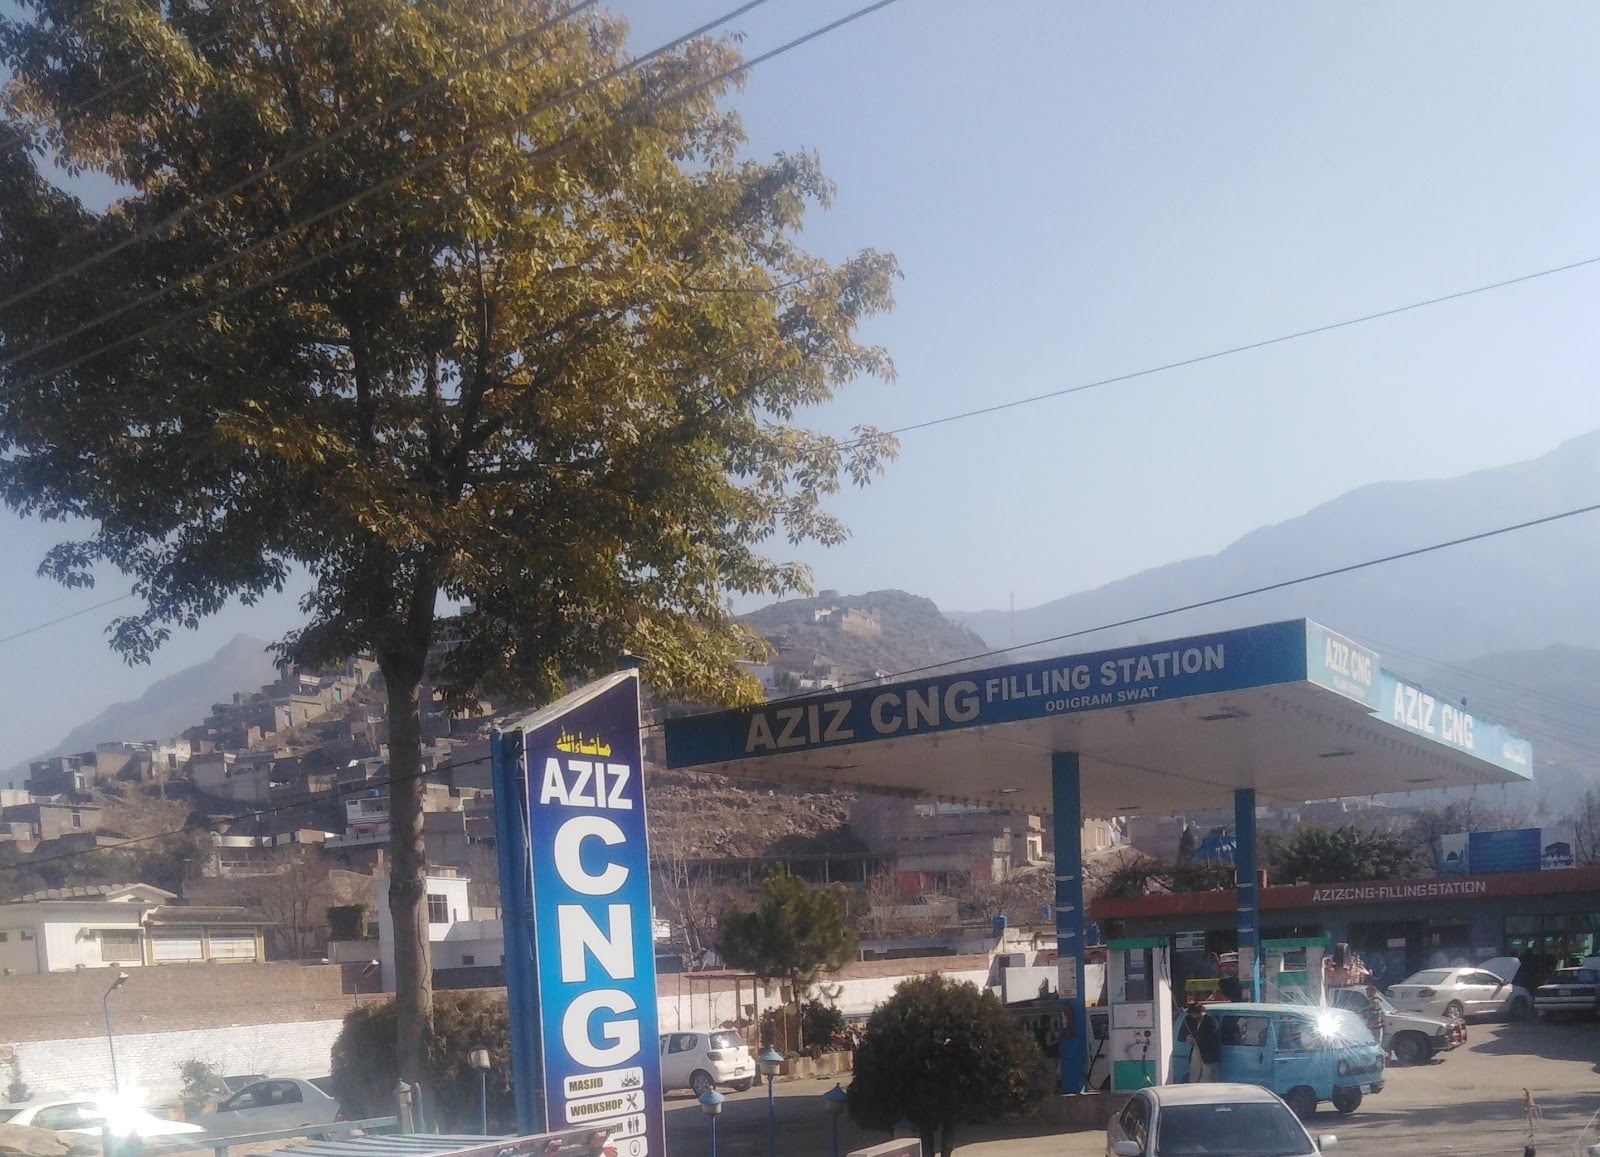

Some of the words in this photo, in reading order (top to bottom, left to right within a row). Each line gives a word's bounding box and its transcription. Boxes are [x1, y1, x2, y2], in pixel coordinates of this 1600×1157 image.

[985, 664, 1091, 703] FILLING
[1100, 643, 1225, 687] STATION
[1325, 637, 1349, 676] AZIZ
[1351, 650, 1371, 686] CNG
[745, 700, 854, 753] AZIZ
[870, 680, 980, 735] CNG
[1045, 692, 1113, 713] ODIGRAM
[1117, 686, 1159, 703] SWAT
[1394, 681, 1435, 734] AZIZ
[1442, 703, 1473, 750] CNG
[540, 757, 633, 810] AZIZ
[568, 1077, 604, 1092] MASJID
[570, 1099, 624, 1117] WORKSHOP
